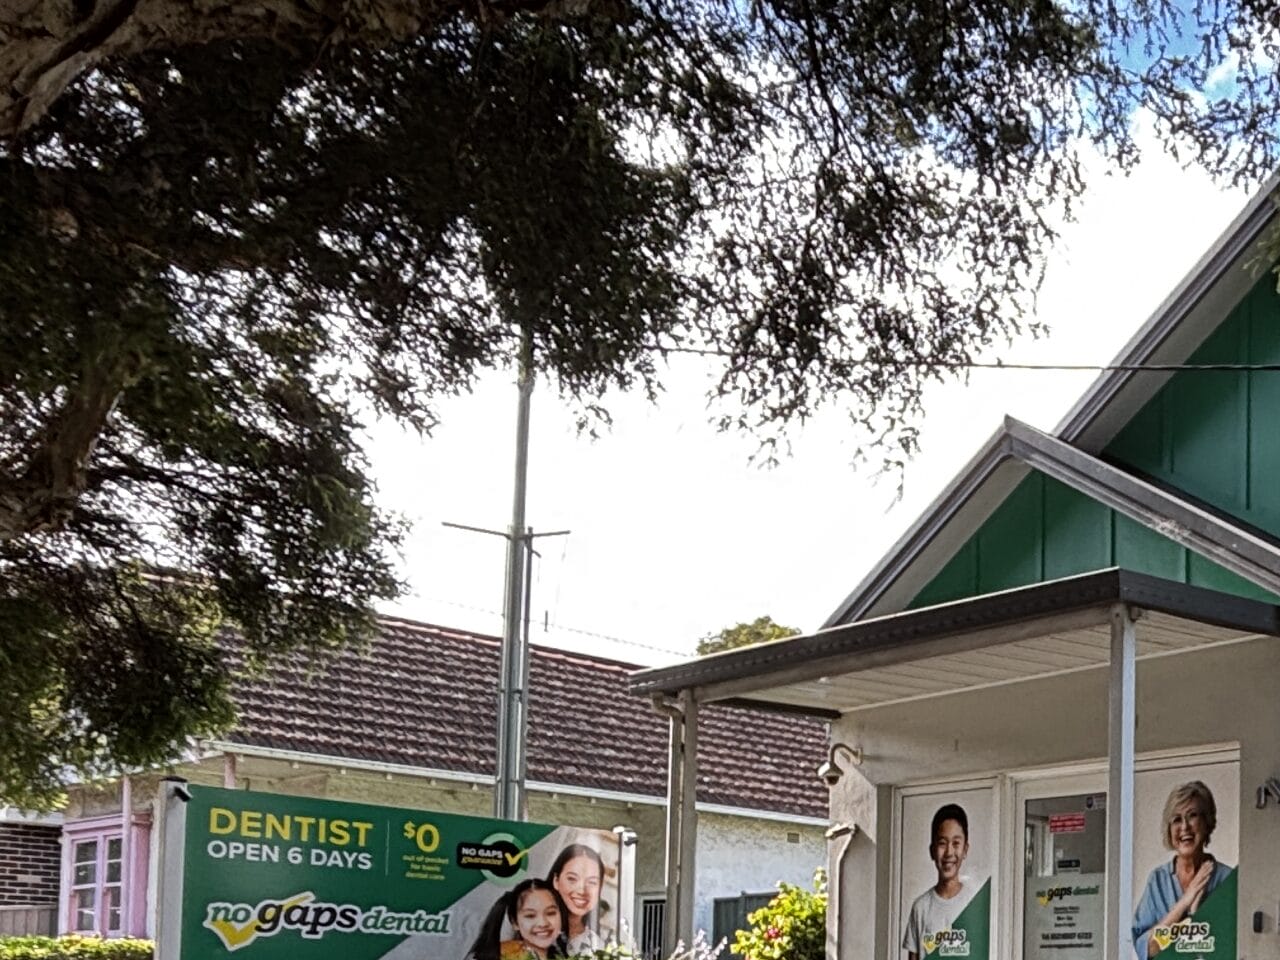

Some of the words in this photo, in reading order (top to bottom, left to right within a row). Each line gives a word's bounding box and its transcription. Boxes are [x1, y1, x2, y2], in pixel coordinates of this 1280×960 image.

[209, 807, 374, 848] DENTIST
[403, 821, 440, 853] $0
[207, 840, 280, 863] OPEN
[287, 847, 304, 865] 6
[310, 849, 373, 870] DAYS
[461, 847, 477, 856] NO
[478, 849, 503, 859] GAPS
[1047, 886, 1073, 901] gaps
[211, 904, 250, 923] no
[255, 903, 359, 935] gaps
[362, 909, 450, 933] dental
[935, 930, 964, 945] gaps
[1154, 927, 1168, 936] no
[1170, 924, 1208, 940] gaps
[1177, 937, 1213, 950] dental
